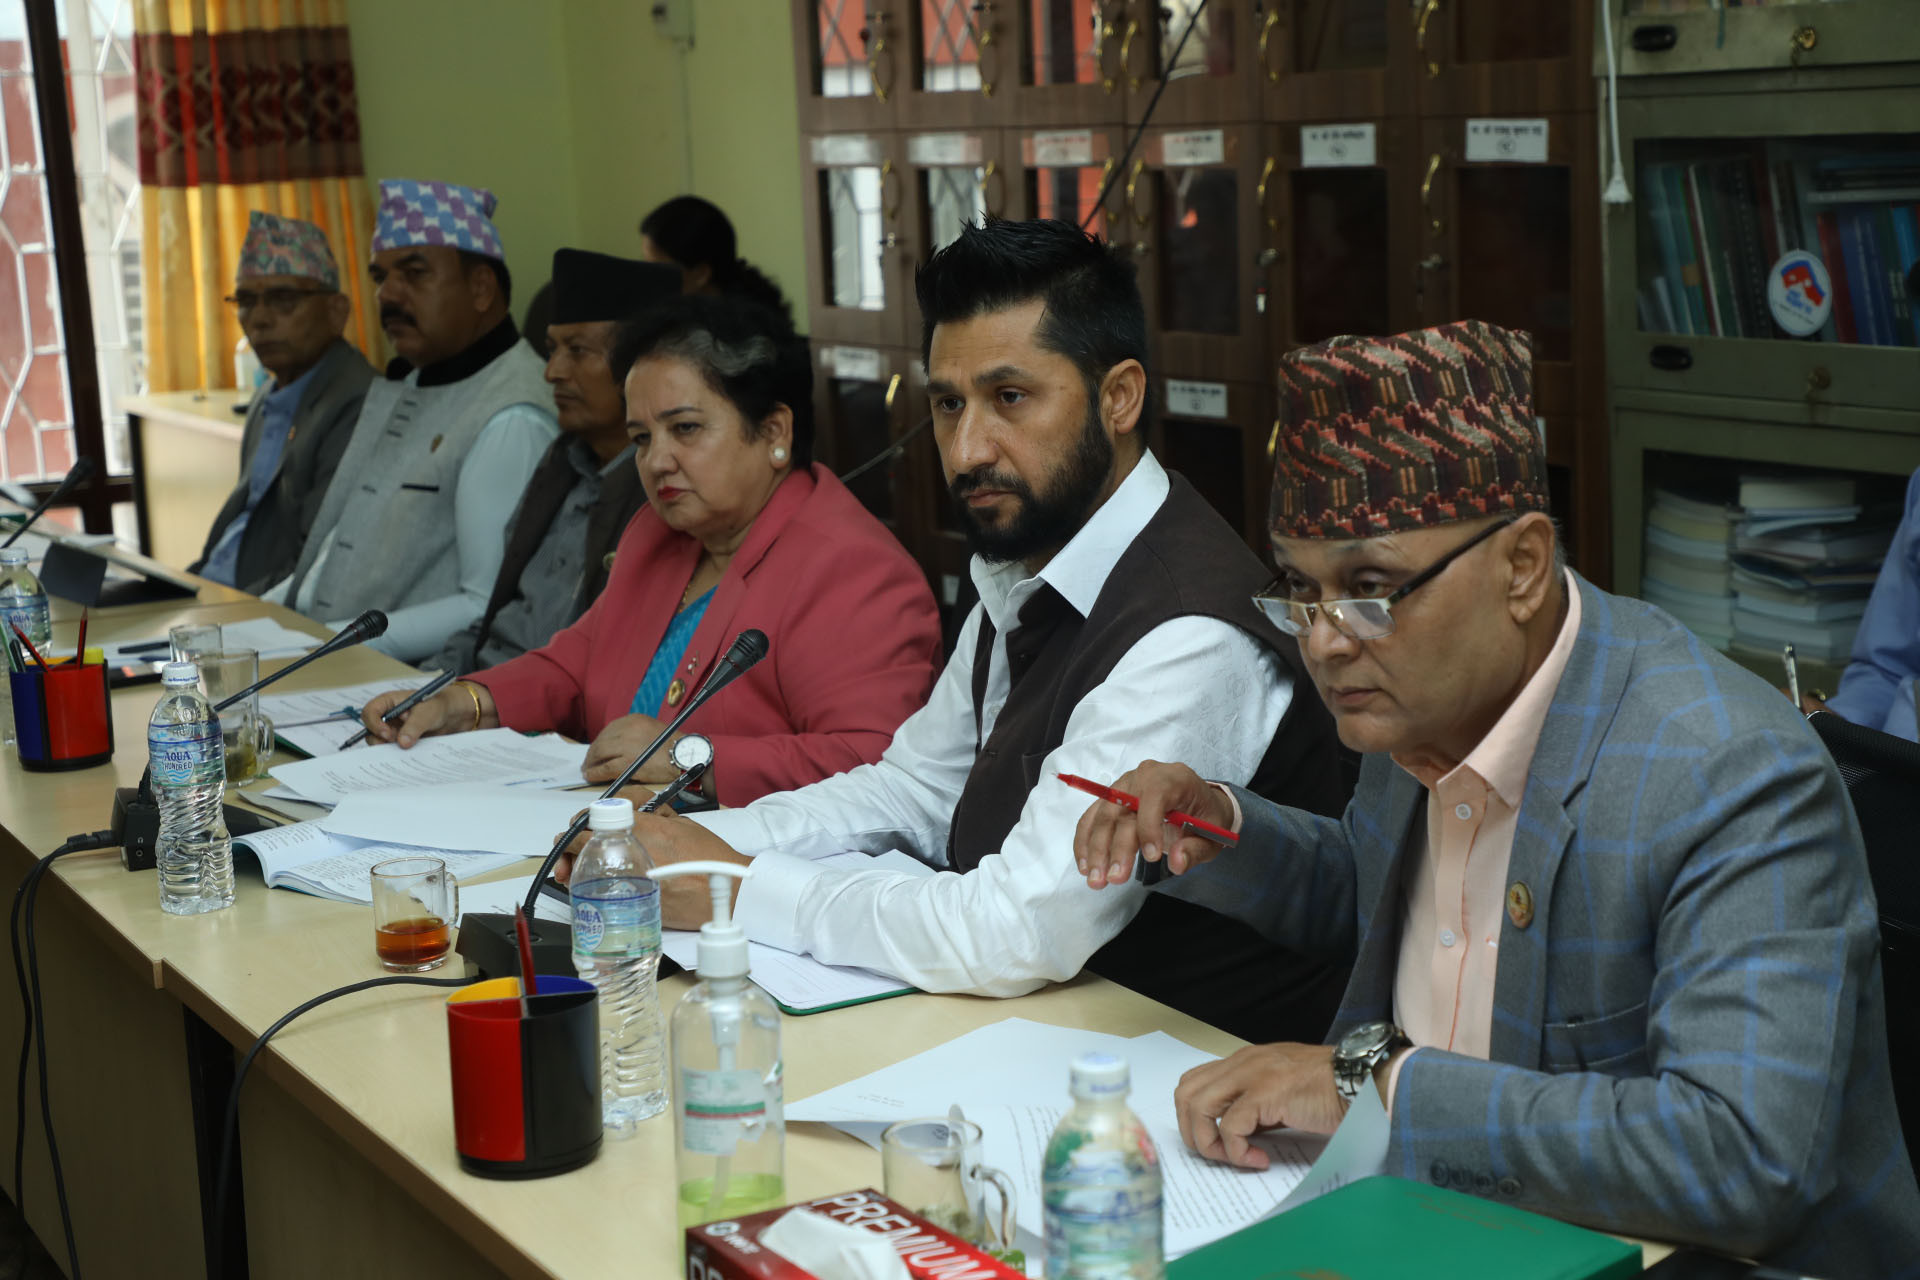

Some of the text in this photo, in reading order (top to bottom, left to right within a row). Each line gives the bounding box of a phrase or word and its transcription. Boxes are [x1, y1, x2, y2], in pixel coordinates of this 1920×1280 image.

[164, 751, 190, 763] AQUA
[164, 761, 192, 771] HUNDRED
[575, 908, 601, 923] AQUA
[811, 1192, 998, 1280] PREMIUM
